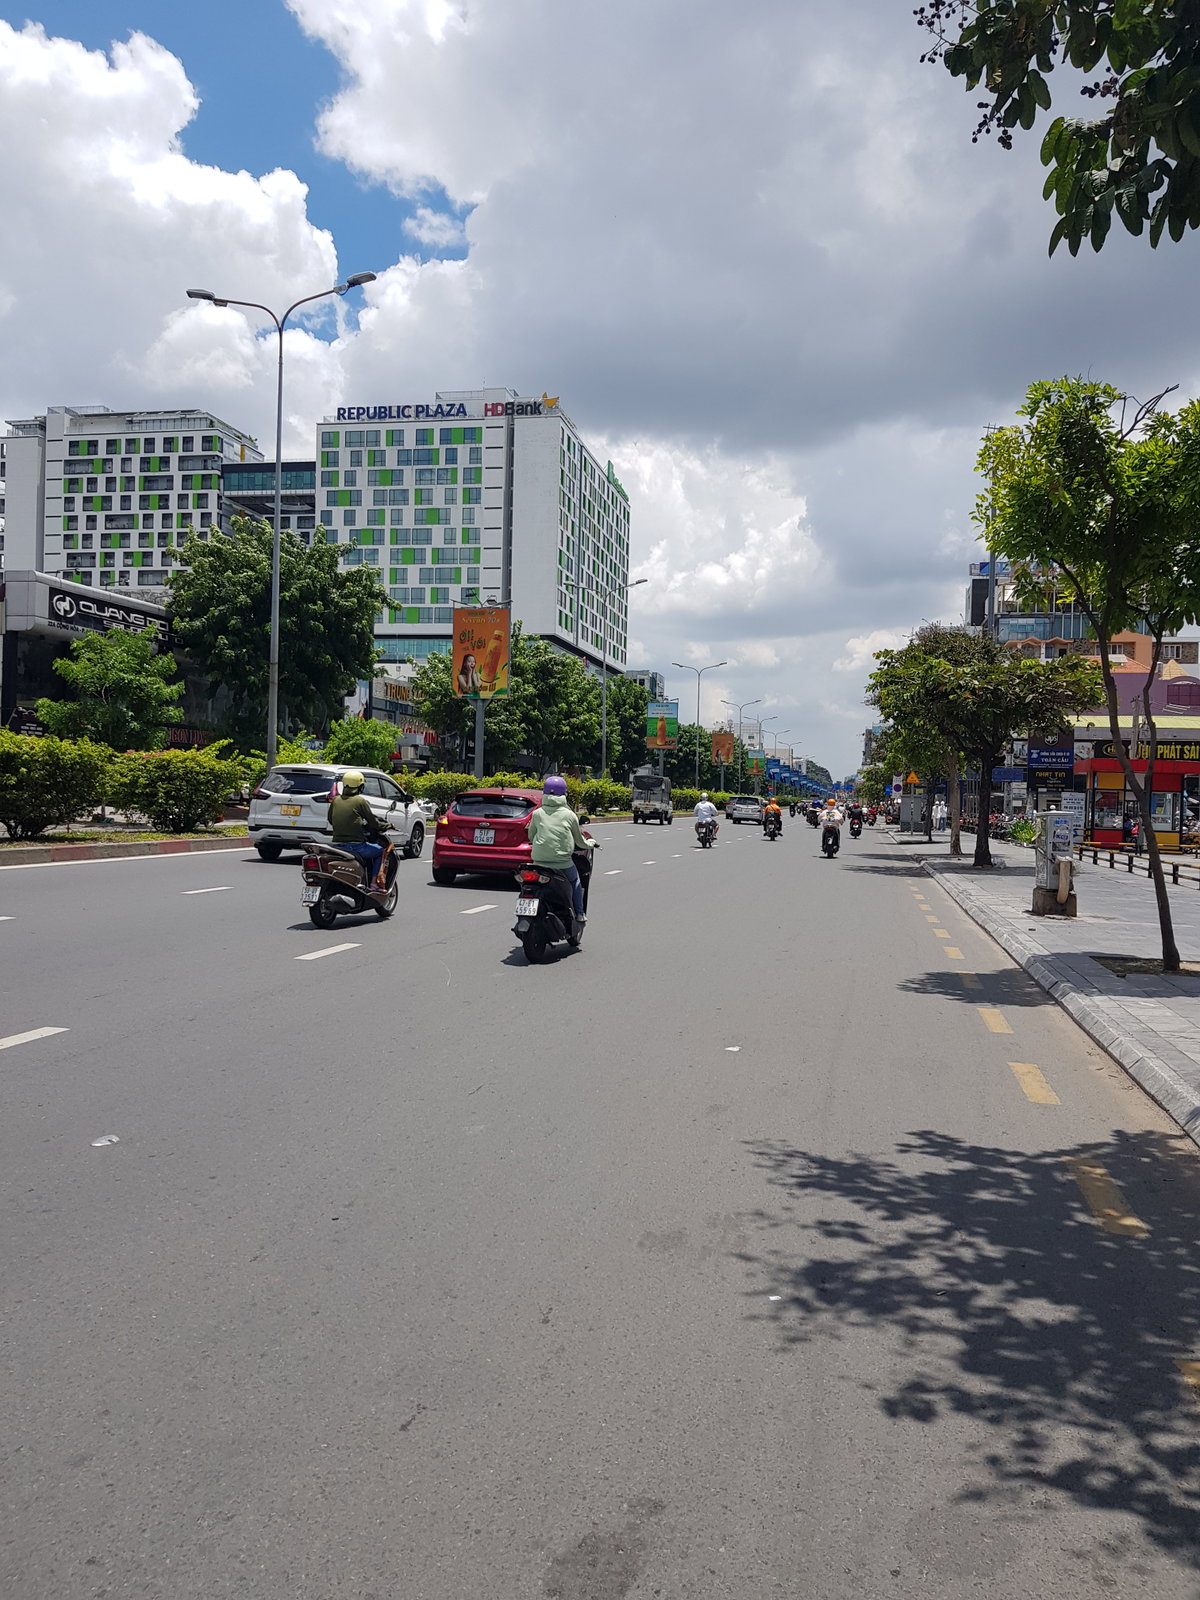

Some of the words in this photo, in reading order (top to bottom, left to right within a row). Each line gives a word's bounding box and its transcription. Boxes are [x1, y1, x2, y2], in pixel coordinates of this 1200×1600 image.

[336, 405, 412, 420] REPUBLIC
[415, 403, 467, 417] PLAZA
[484, 401, 542, 416] HDBank
[79, 601, 145, 626] QUANG
